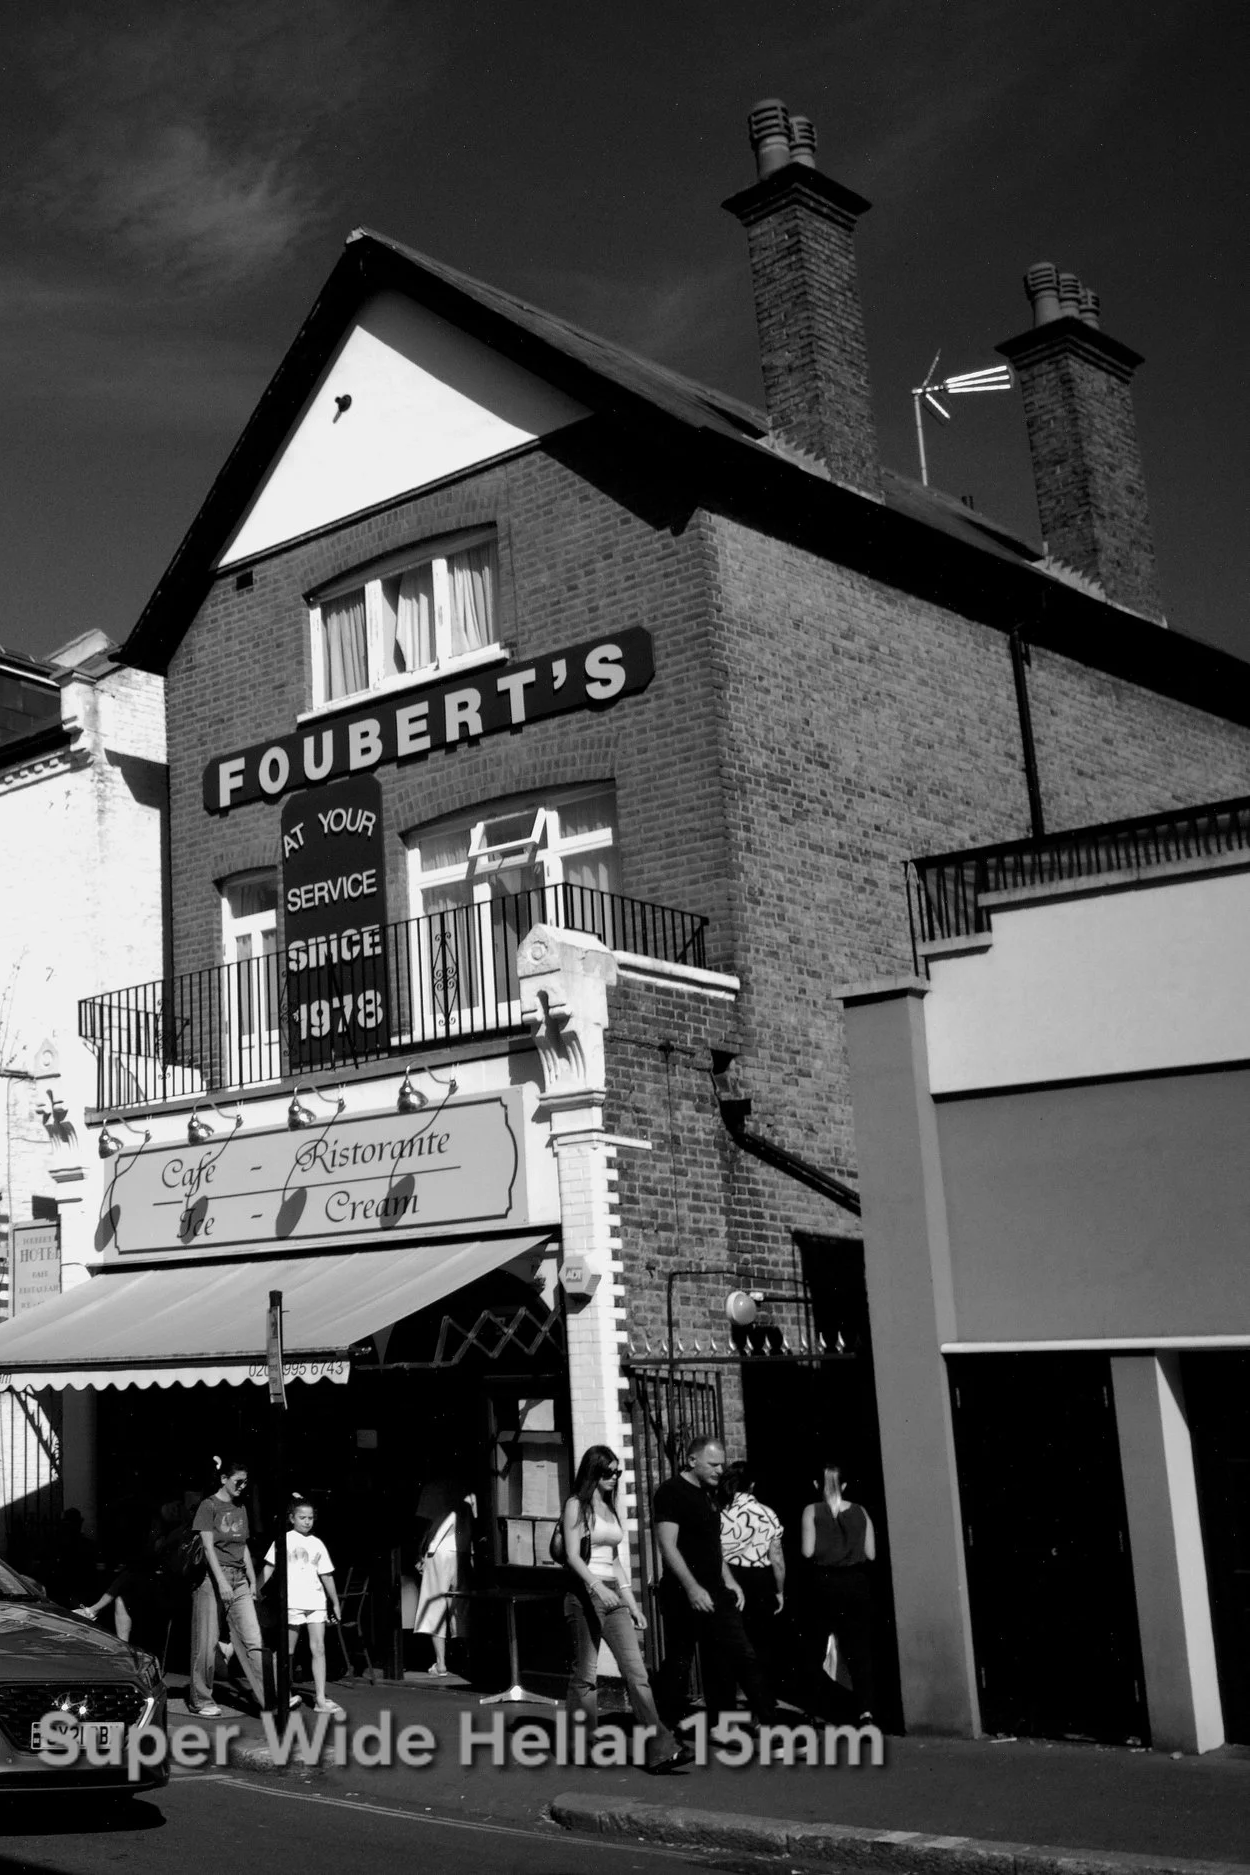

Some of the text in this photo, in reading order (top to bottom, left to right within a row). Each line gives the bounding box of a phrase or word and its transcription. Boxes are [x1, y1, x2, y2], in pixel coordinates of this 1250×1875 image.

[218, 642, 626, 808] FOUBERT'S
[282, 806, 377, 859] AT YOUR
[287, 868, 378, 914] SERVICE
[287, 924, 383, 973] SINCE
[293, 988, 384, 1042] 1978
[295, 1130, 451, 1174] Ristorante
[177, 1208, 216, 1239] Ice
[324, 1190, 421, 1224] Cream
[20, 1246, 61, 1263] HOTEL
[566, 1269, 583, 1281] ADT
[283, 1363, 307, 1376] 995
[310, 1361, 344, 1375] 6743
